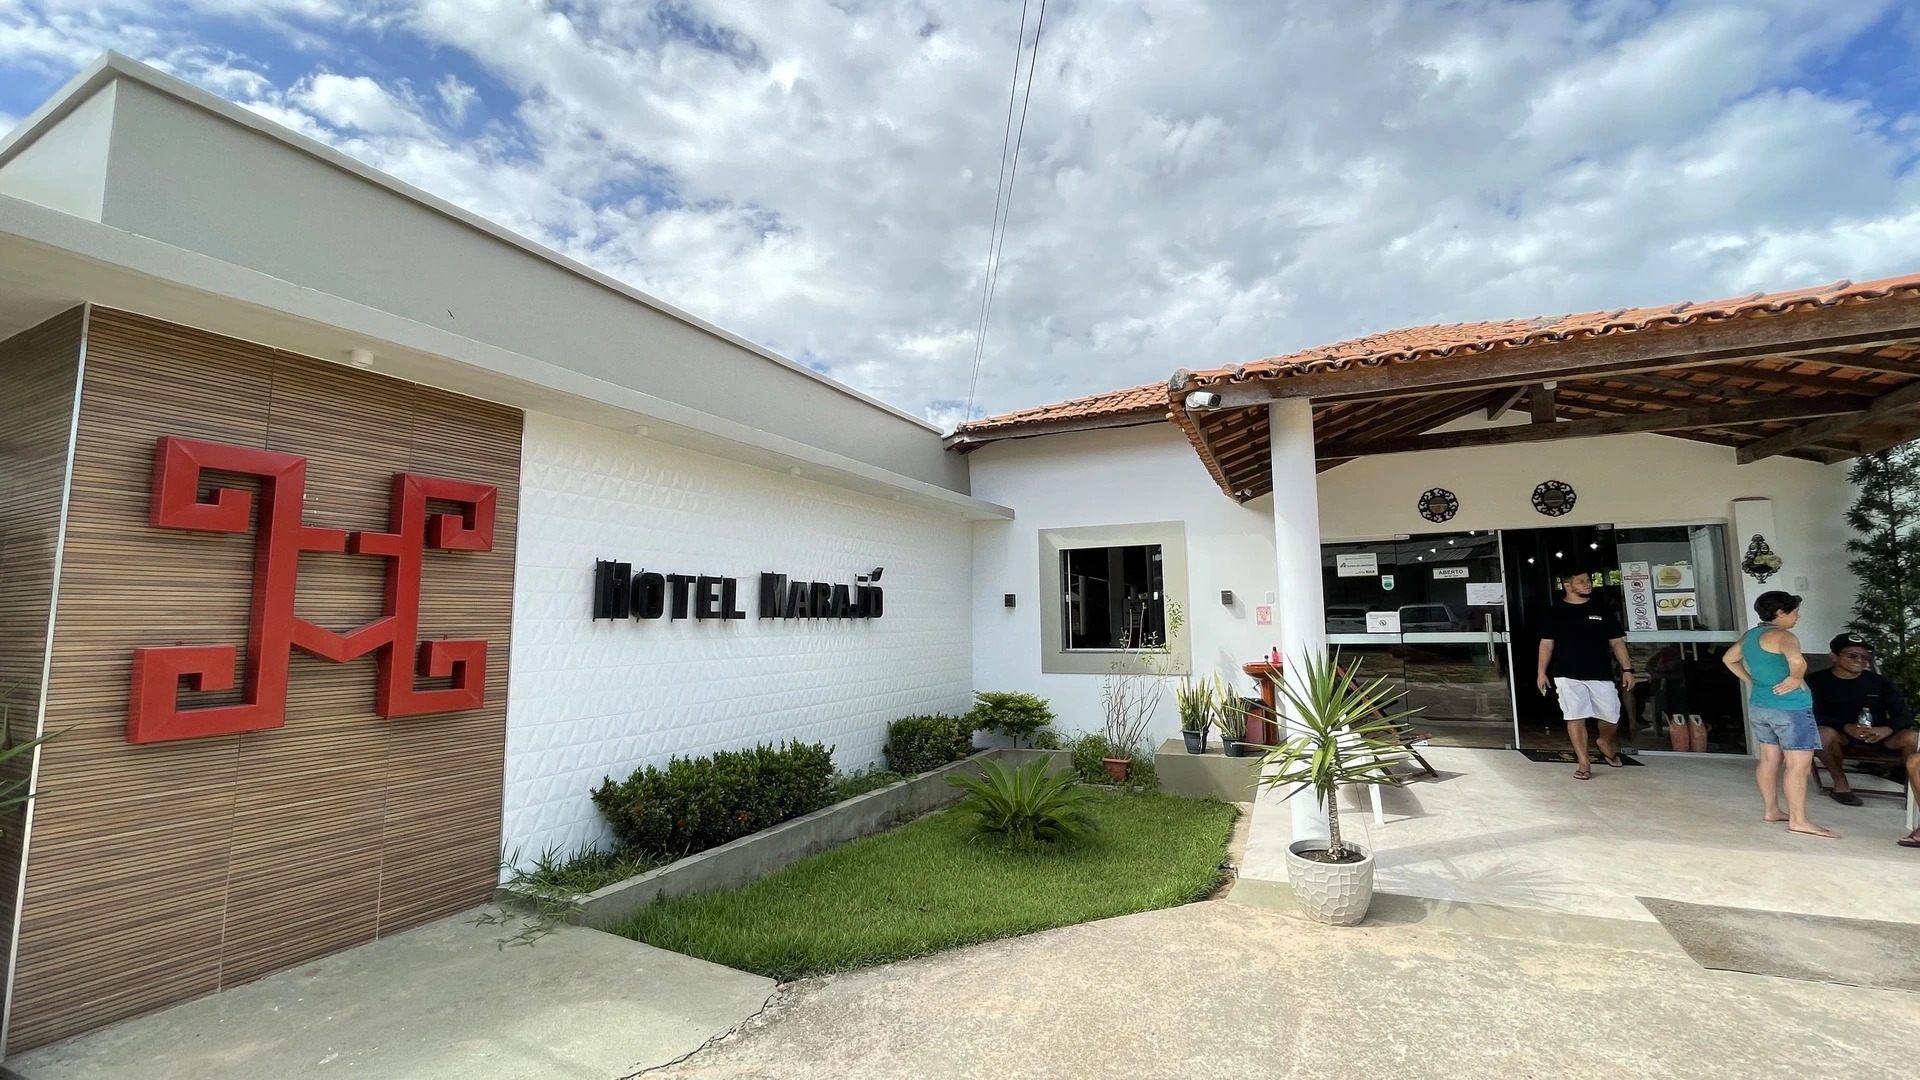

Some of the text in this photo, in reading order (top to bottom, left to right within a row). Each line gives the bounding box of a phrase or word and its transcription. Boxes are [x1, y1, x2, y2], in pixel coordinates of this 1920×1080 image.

[594, 560, 884, 619] HOTEL MARAJÓ
[1656, 598, 1695, 608] CVC
